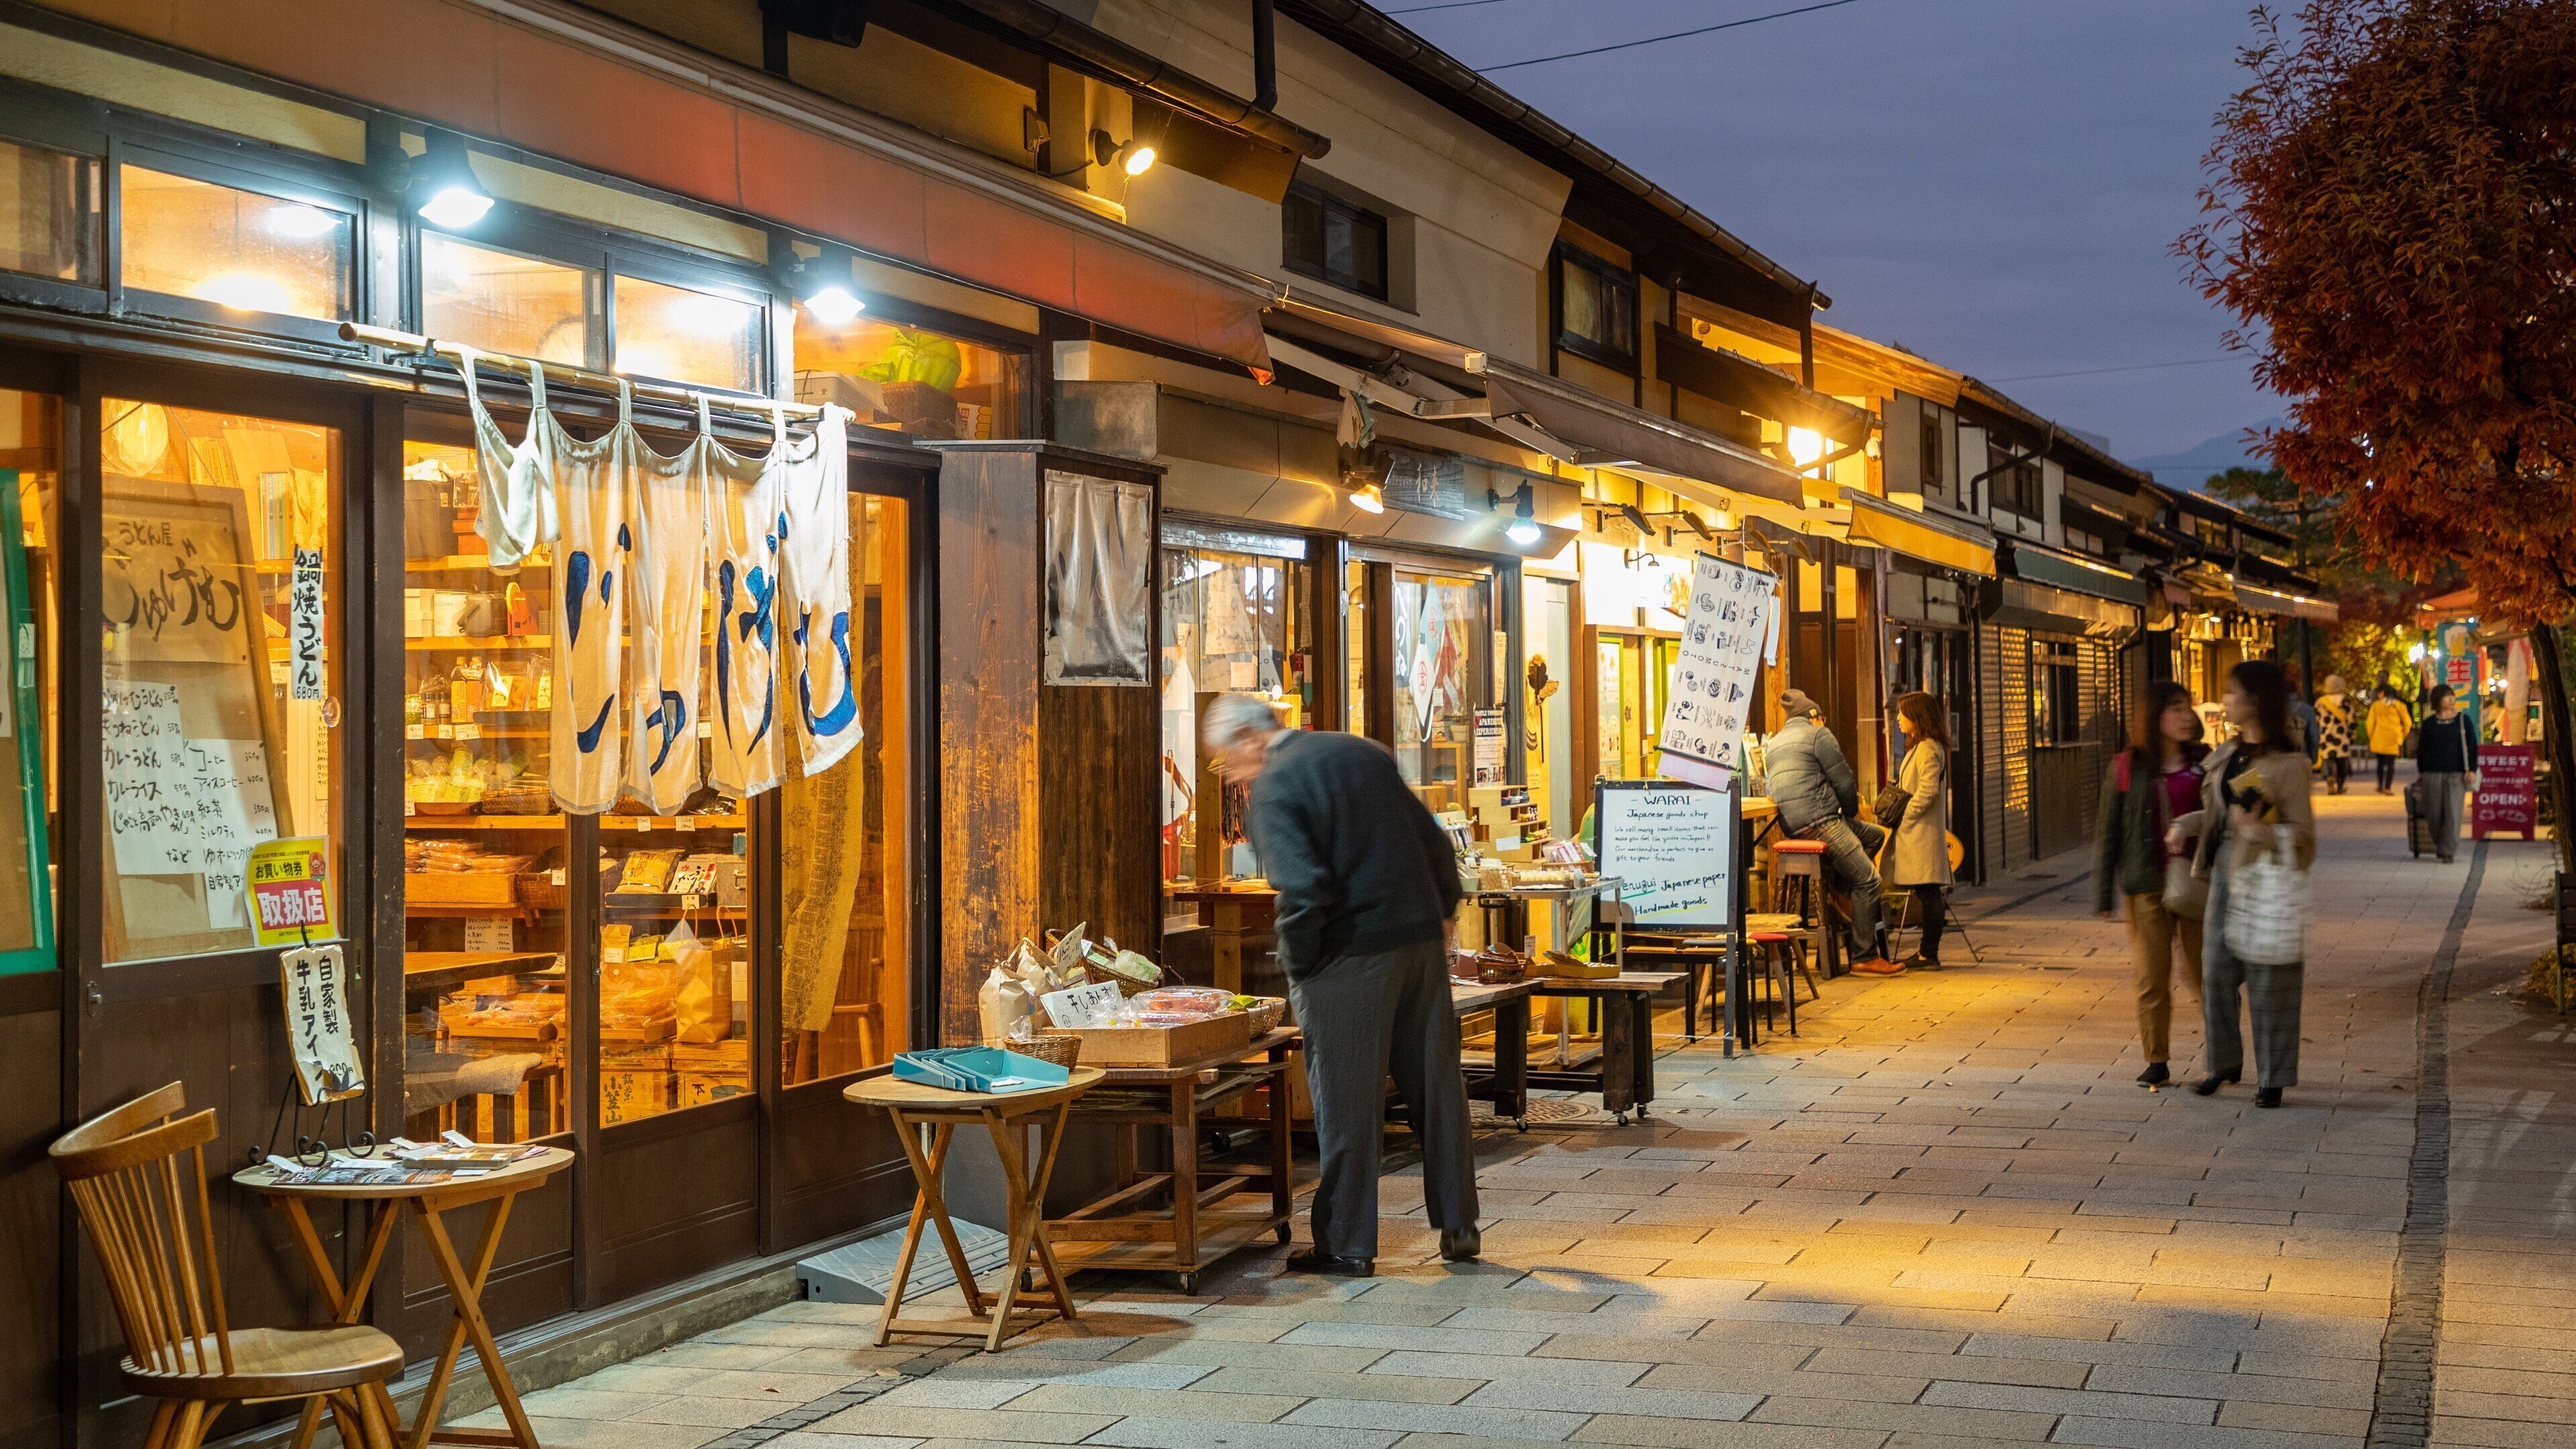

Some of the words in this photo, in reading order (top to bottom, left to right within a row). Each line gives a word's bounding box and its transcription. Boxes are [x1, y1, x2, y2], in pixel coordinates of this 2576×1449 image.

[119, 519, 173, 547] うどん屋
[293, 549, 322, 687] 鍋焼うどん
[296, 686, 320, 700] 680円
[103, 745, 161, 770] カレーうどん
[189, 747, 225, 772] コーヒー
[2477, 755, 2530, 767] SWEET
[107, 780, 162, 802] カレーライス
[193, 776, 244, 792] アイスコーヒー
[1644, 795, 1691, 806] WARAI
[2478, 792, 2518, 805] OPEN
[197, 799, 223, 820] 紅茶
[1627, 809, 1664, 821] Japanese
[1666, 810, 1686, 820] goods
[1689, 809, 1709, 820] shop
[201, 825, 235, 840] ミルクティ
[166, 849, 192, 863] など
[1654, 853, 1675, 862] friends
[1666, 846, 1686, 854] perfect
[255, 861, 303, 879] お買い物券
[208, 871, 244, 892] 自家製ア
[1621, 877, 1656, 893] enugui
[1660, 877, 1701, 892] Japanese
[1703, 872, 1727, 888] paper
[256, 887, 326, 926] 取扱店
[1634, 901, 1679, 916] Handmade
[1681, 896, 1708, 910] goods
[319, 955, 339, 1034] 自家製
[1067, 985, 1113, 1014] 干しあんず
[621, 1073, 634, 1102] 銘茶
[603, 1075, 623, 1125] 小笠山
